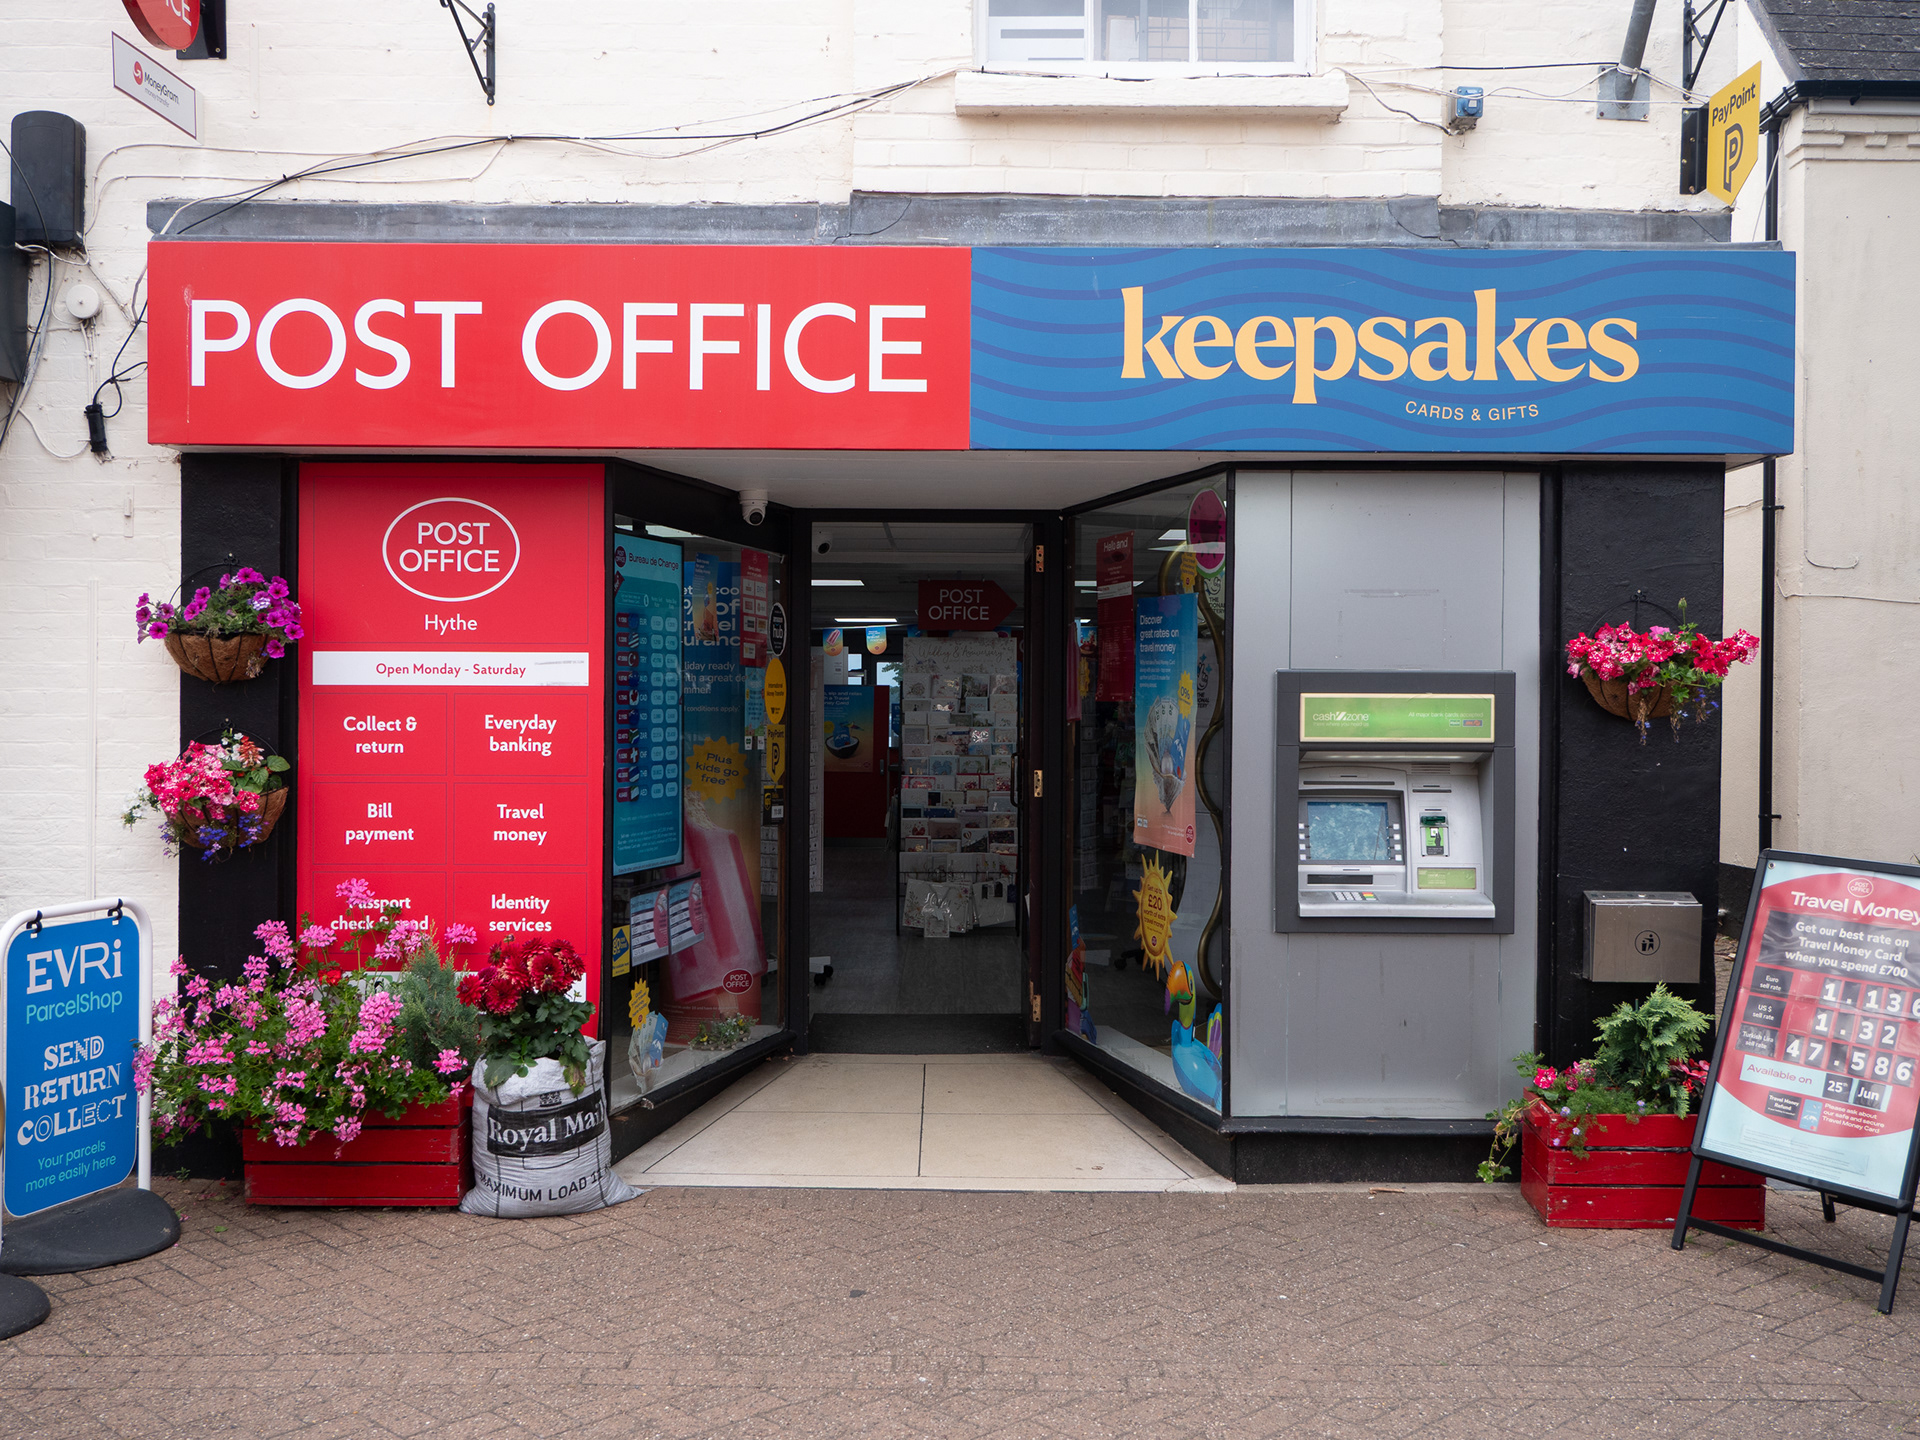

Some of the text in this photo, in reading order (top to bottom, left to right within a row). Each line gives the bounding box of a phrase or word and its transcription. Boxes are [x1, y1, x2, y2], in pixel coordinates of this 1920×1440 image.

[144, 72, 179, 103] MoneyGram
[1712, 82, 1756, 127] PayPoint
[190, 299, 928, 394] POST OFFICE
[1121, 287, 1640, 405] keepsakes
[1405, 400, 1539, 421] CARDS & GIFTS
[418, 522, 490, 545] POST
[1103, 537, 1128, 553] Hello and
[399, 549, 500, 572] OFFICE
[628, 552, 679, 571] Bureau de Change
[939, 589, 983, 604] POST
[928, 605, 990, 621] OFFICE
[1140, 615, 1163, 625] Discover
[425, 614, 478, 636] Hythe
[1140, 631, 1154, 641] great
[1154, 629, 1170, 638] rates
[919, 645, 1003, 663] Wedding & Anniversary
[1140, 643, 1177, 656] travel money
[376, 663, 526, 678] Open Monday Saturday
[684, 661, 736, 673] liday ready
[685, 673, 748, 685] ith great de
[343, 716, 417, 732] Collect &
[485, 714, 557, 734] Everyday
[767, 729, 784, 740] PayPoint
[356, 741, 404, 754] return
[490, 736, 552, 757] banking
[706, 753, 732, 765] Plus
[695, 762, 740, 779] kids go
[367, 803, 393, 818] Bill
[497, 803, 544, 819] Travel
[345, 828, 415, 845] payment
[493, 829, 547, 846] money
[1850, 886, 1870, 894] OFFICE
[349, 897, 411, 913] ssport
[491, 894, 550, 914] Identity
[1148, 894, 1163, 911] £20
[1791, 891, 1920, 926] Travel Money
[331, 915, 375, 930] check
[1144, 909, 1166, 922] worth extra
[1144, 916, 1153, 925] travel
[489, 917, 552, 932] services
[1795, 921, 1909, 948] Get our best rate on
[1798, 936, 1903, 962] Travel Money Card
[1784, 950, 1908, 979] when you spend £700
[725, 980, 749, 988] OFFICE
[1760, 981, 1768, 989] sell
[1766, 974, 1779, 983] Euro
[26, 990, 123, 1025] ParcelShop
[1758, 1004, 1772, 1013] US $
[1752, 1011, 1774, 1021] sell rate
[1742, 1030, 1774, 1043] Turkish Lira
[1745, 1040, 1754, 1048] sell
[44, 1035, 105, 1071] SEND
[1747, 1064, 1812, 1085] Available on
[23, 1063, 122, 1111] RETURN
[1857, 1087, 1879, 1100] Jun
[1769, 1094, 1800, 1108] Travel Money
[1774, 1102, 1792, 1111] Refund
[17, 1093, 127, 1146] COLLECT
[1825, 1103, 1846, 1113] Please
[1859, 1111, 1878, 1120] about
[488, 1101, 604, 1151] Royal Mail
[1822, 1116, 1880, 1134] Travel Money Card
[1835, 1112, 1850, 1121] safe
[1851, 1115, 1862, 1123] and
[1863, 1120, 1885, 1128] secure
[38, 1140, 106, 1171] Your parcels
[26, 1154, 117, 1193] more easily here
[479, 1171, 542, 1202] MAXIMUM
[549, 1175, 587, 1201] LOAD
